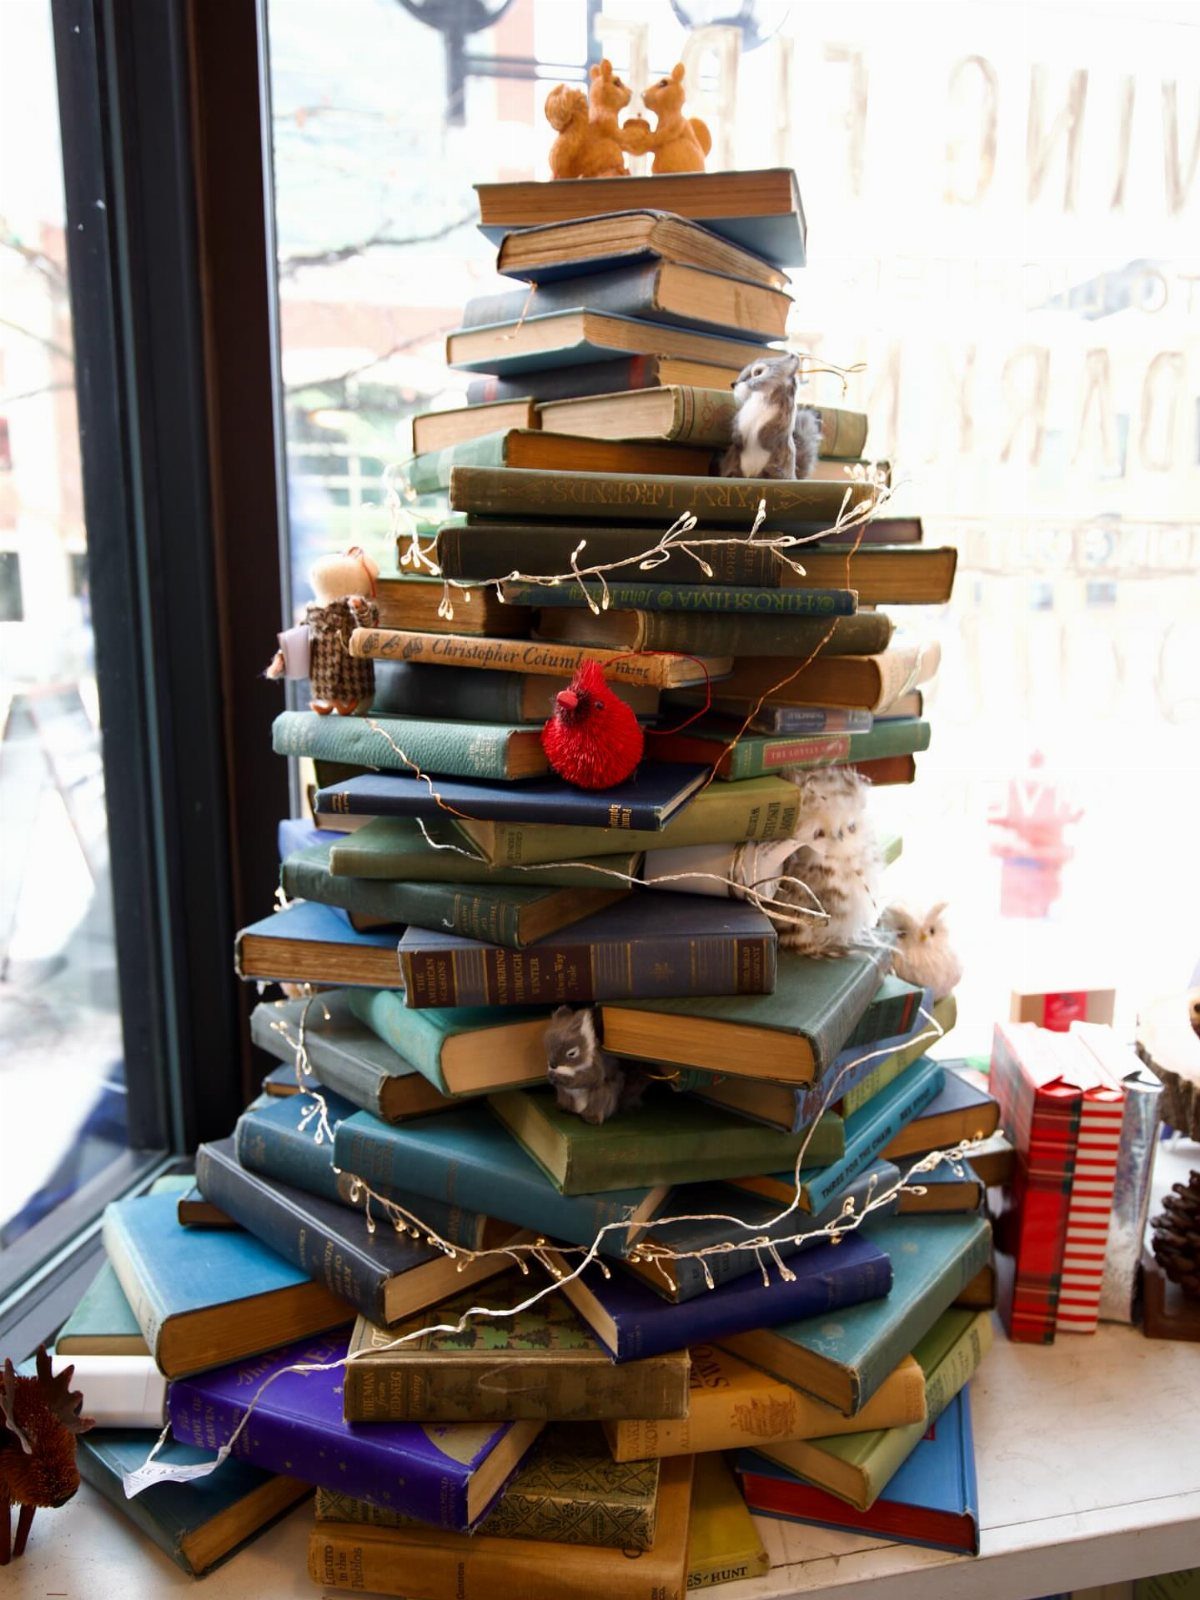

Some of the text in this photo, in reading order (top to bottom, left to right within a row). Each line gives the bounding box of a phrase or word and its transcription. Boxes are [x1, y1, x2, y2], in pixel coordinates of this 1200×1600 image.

[621, 588, 654, 605] John
[677, 590, 817, 611] HIROSHIMA
[432, 638, 520, 664] Christopher
[615, 661, 650, 678] Viking
[822, 1180, 845, 1199] THREE
[711, 1566, 748, 1583] HUNT
